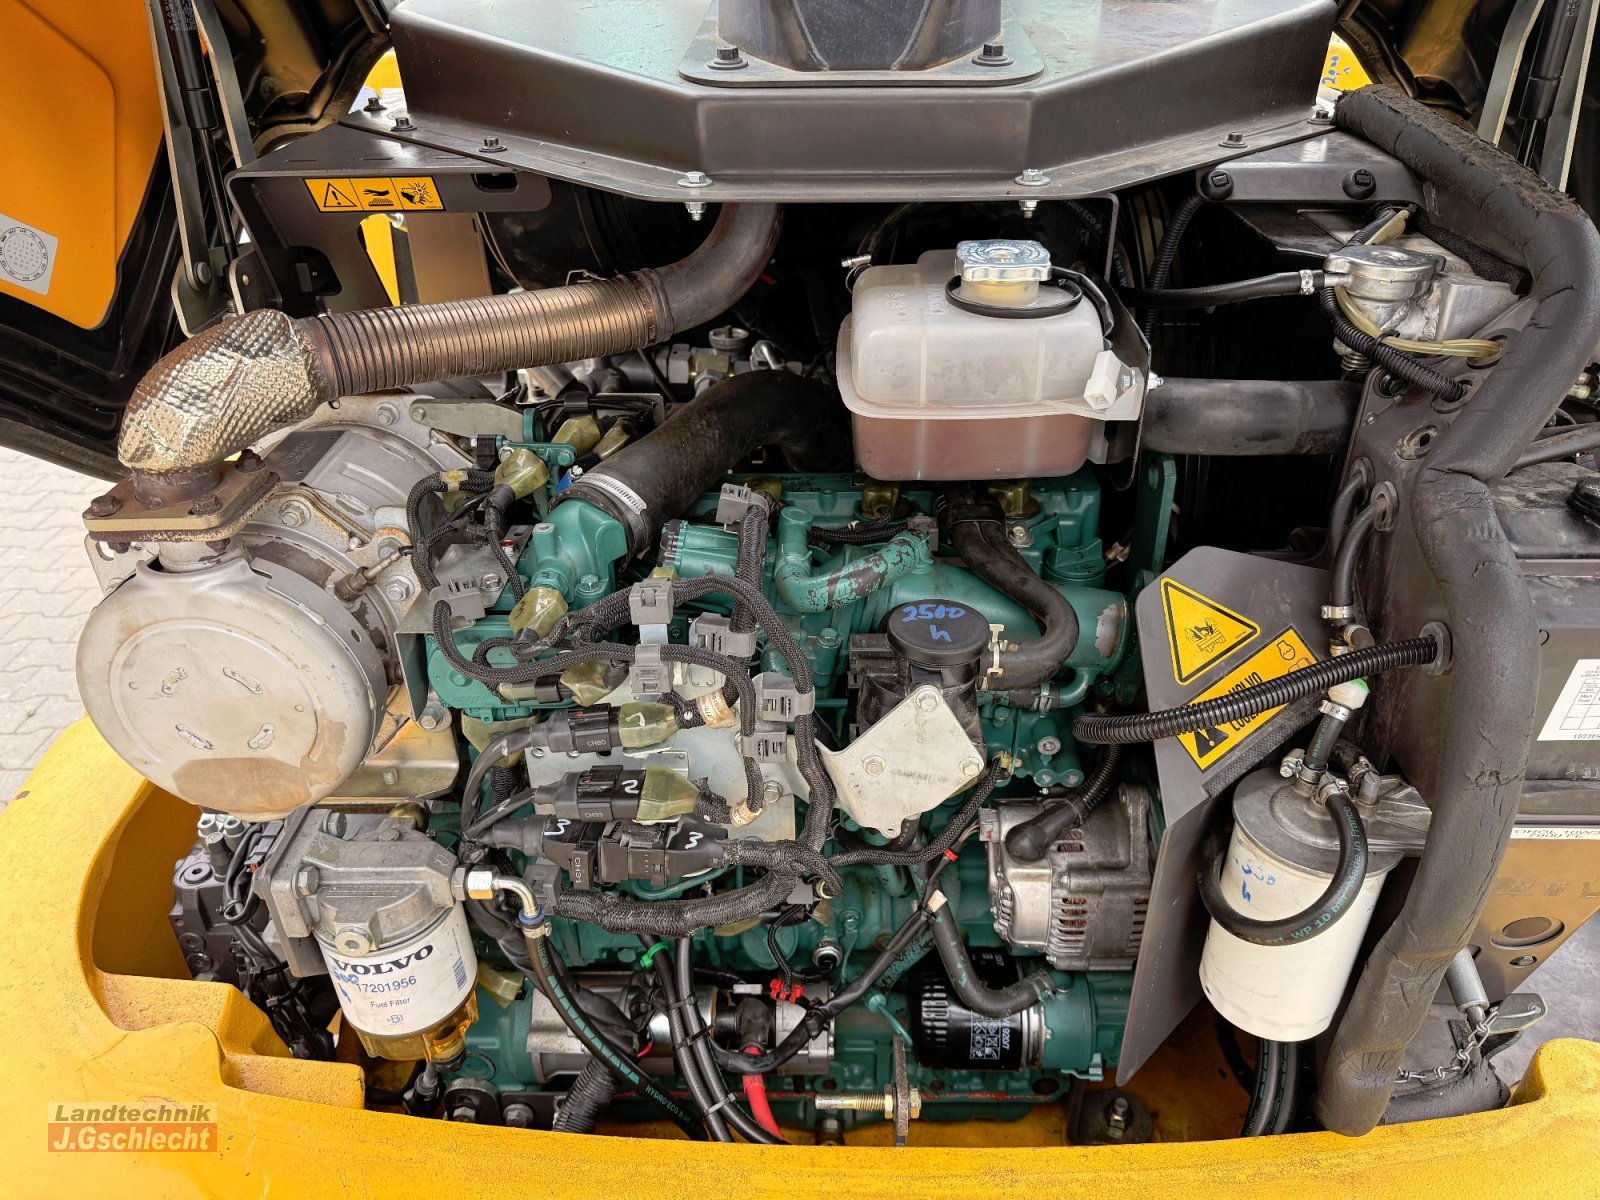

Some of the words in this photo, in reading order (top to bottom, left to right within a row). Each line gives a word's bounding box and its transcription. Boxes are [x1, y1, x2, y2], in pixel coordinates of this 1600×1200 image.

[901, 603, 966, 622] 2500
[621, 779, 640, 794] 2
[1343, 806, 1361, 837] France
[684, 831, 704, 850] 3
[1345, 854, 1361, 888] Made
[1315, 914, 1332, 929] 10
[329, 944, 434, 976] VOLVO
[355, 975, 417, 993] 17201956
[370, 1000, 388, 1008] Fuel
[389, 997, 411, 1007] Filter
